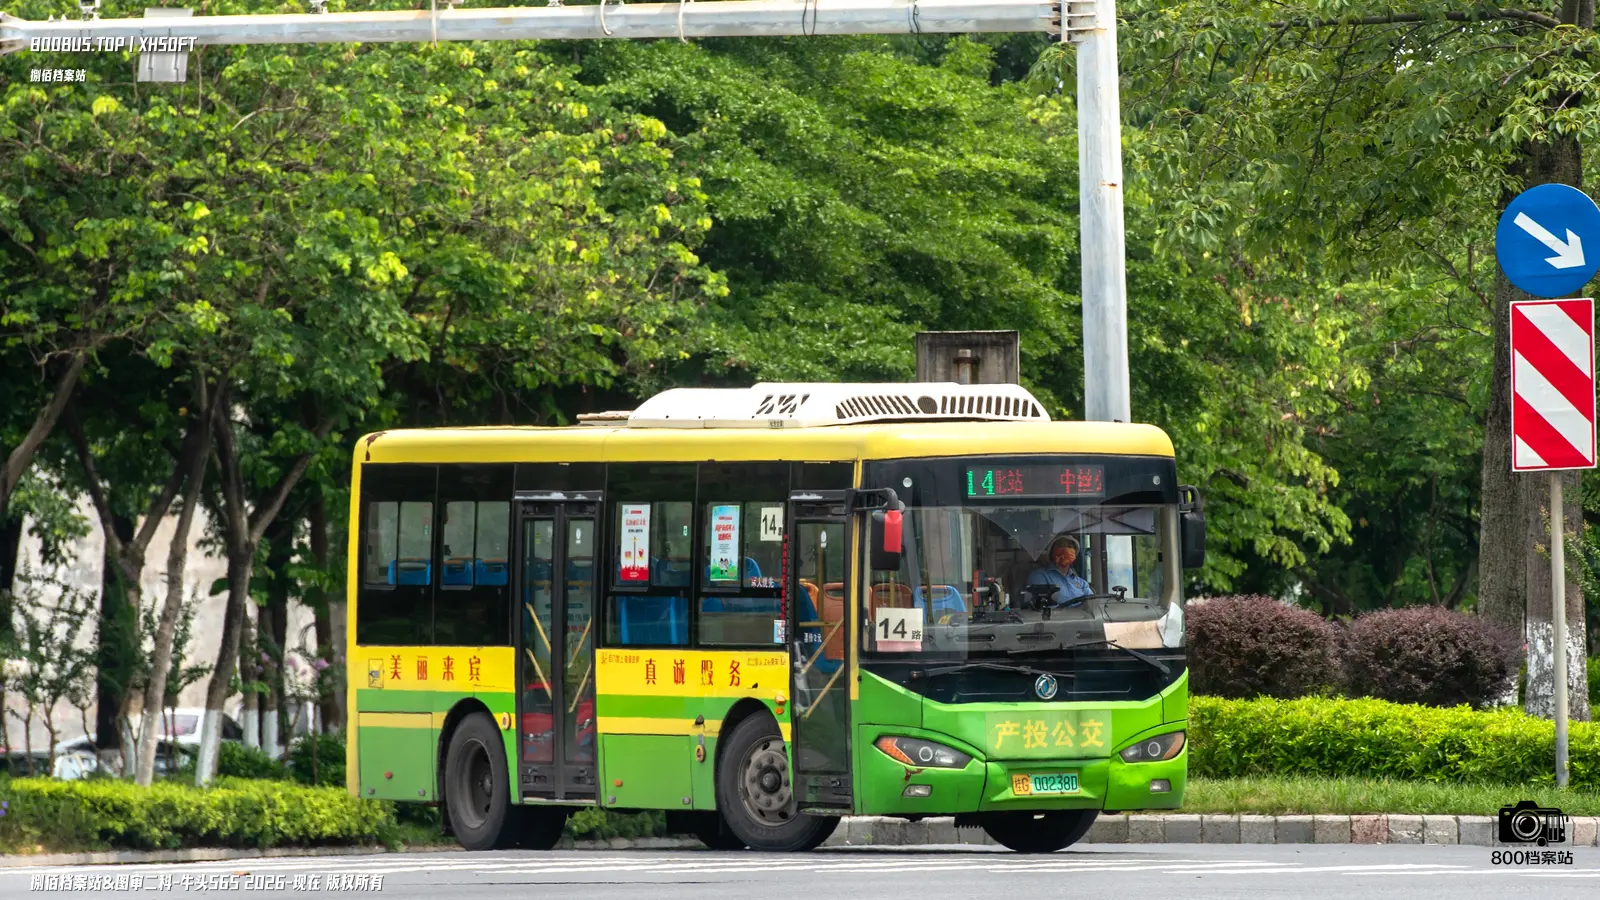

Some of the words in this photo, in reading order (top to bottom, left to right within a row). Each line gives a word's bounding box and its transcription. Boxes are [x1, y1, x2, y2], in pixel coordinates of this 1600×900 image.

[966, 470, 995, 495] 14
[389, 654, 481, 681] 美丽来宾
[994, 719, 1105, 750] 产投公交
